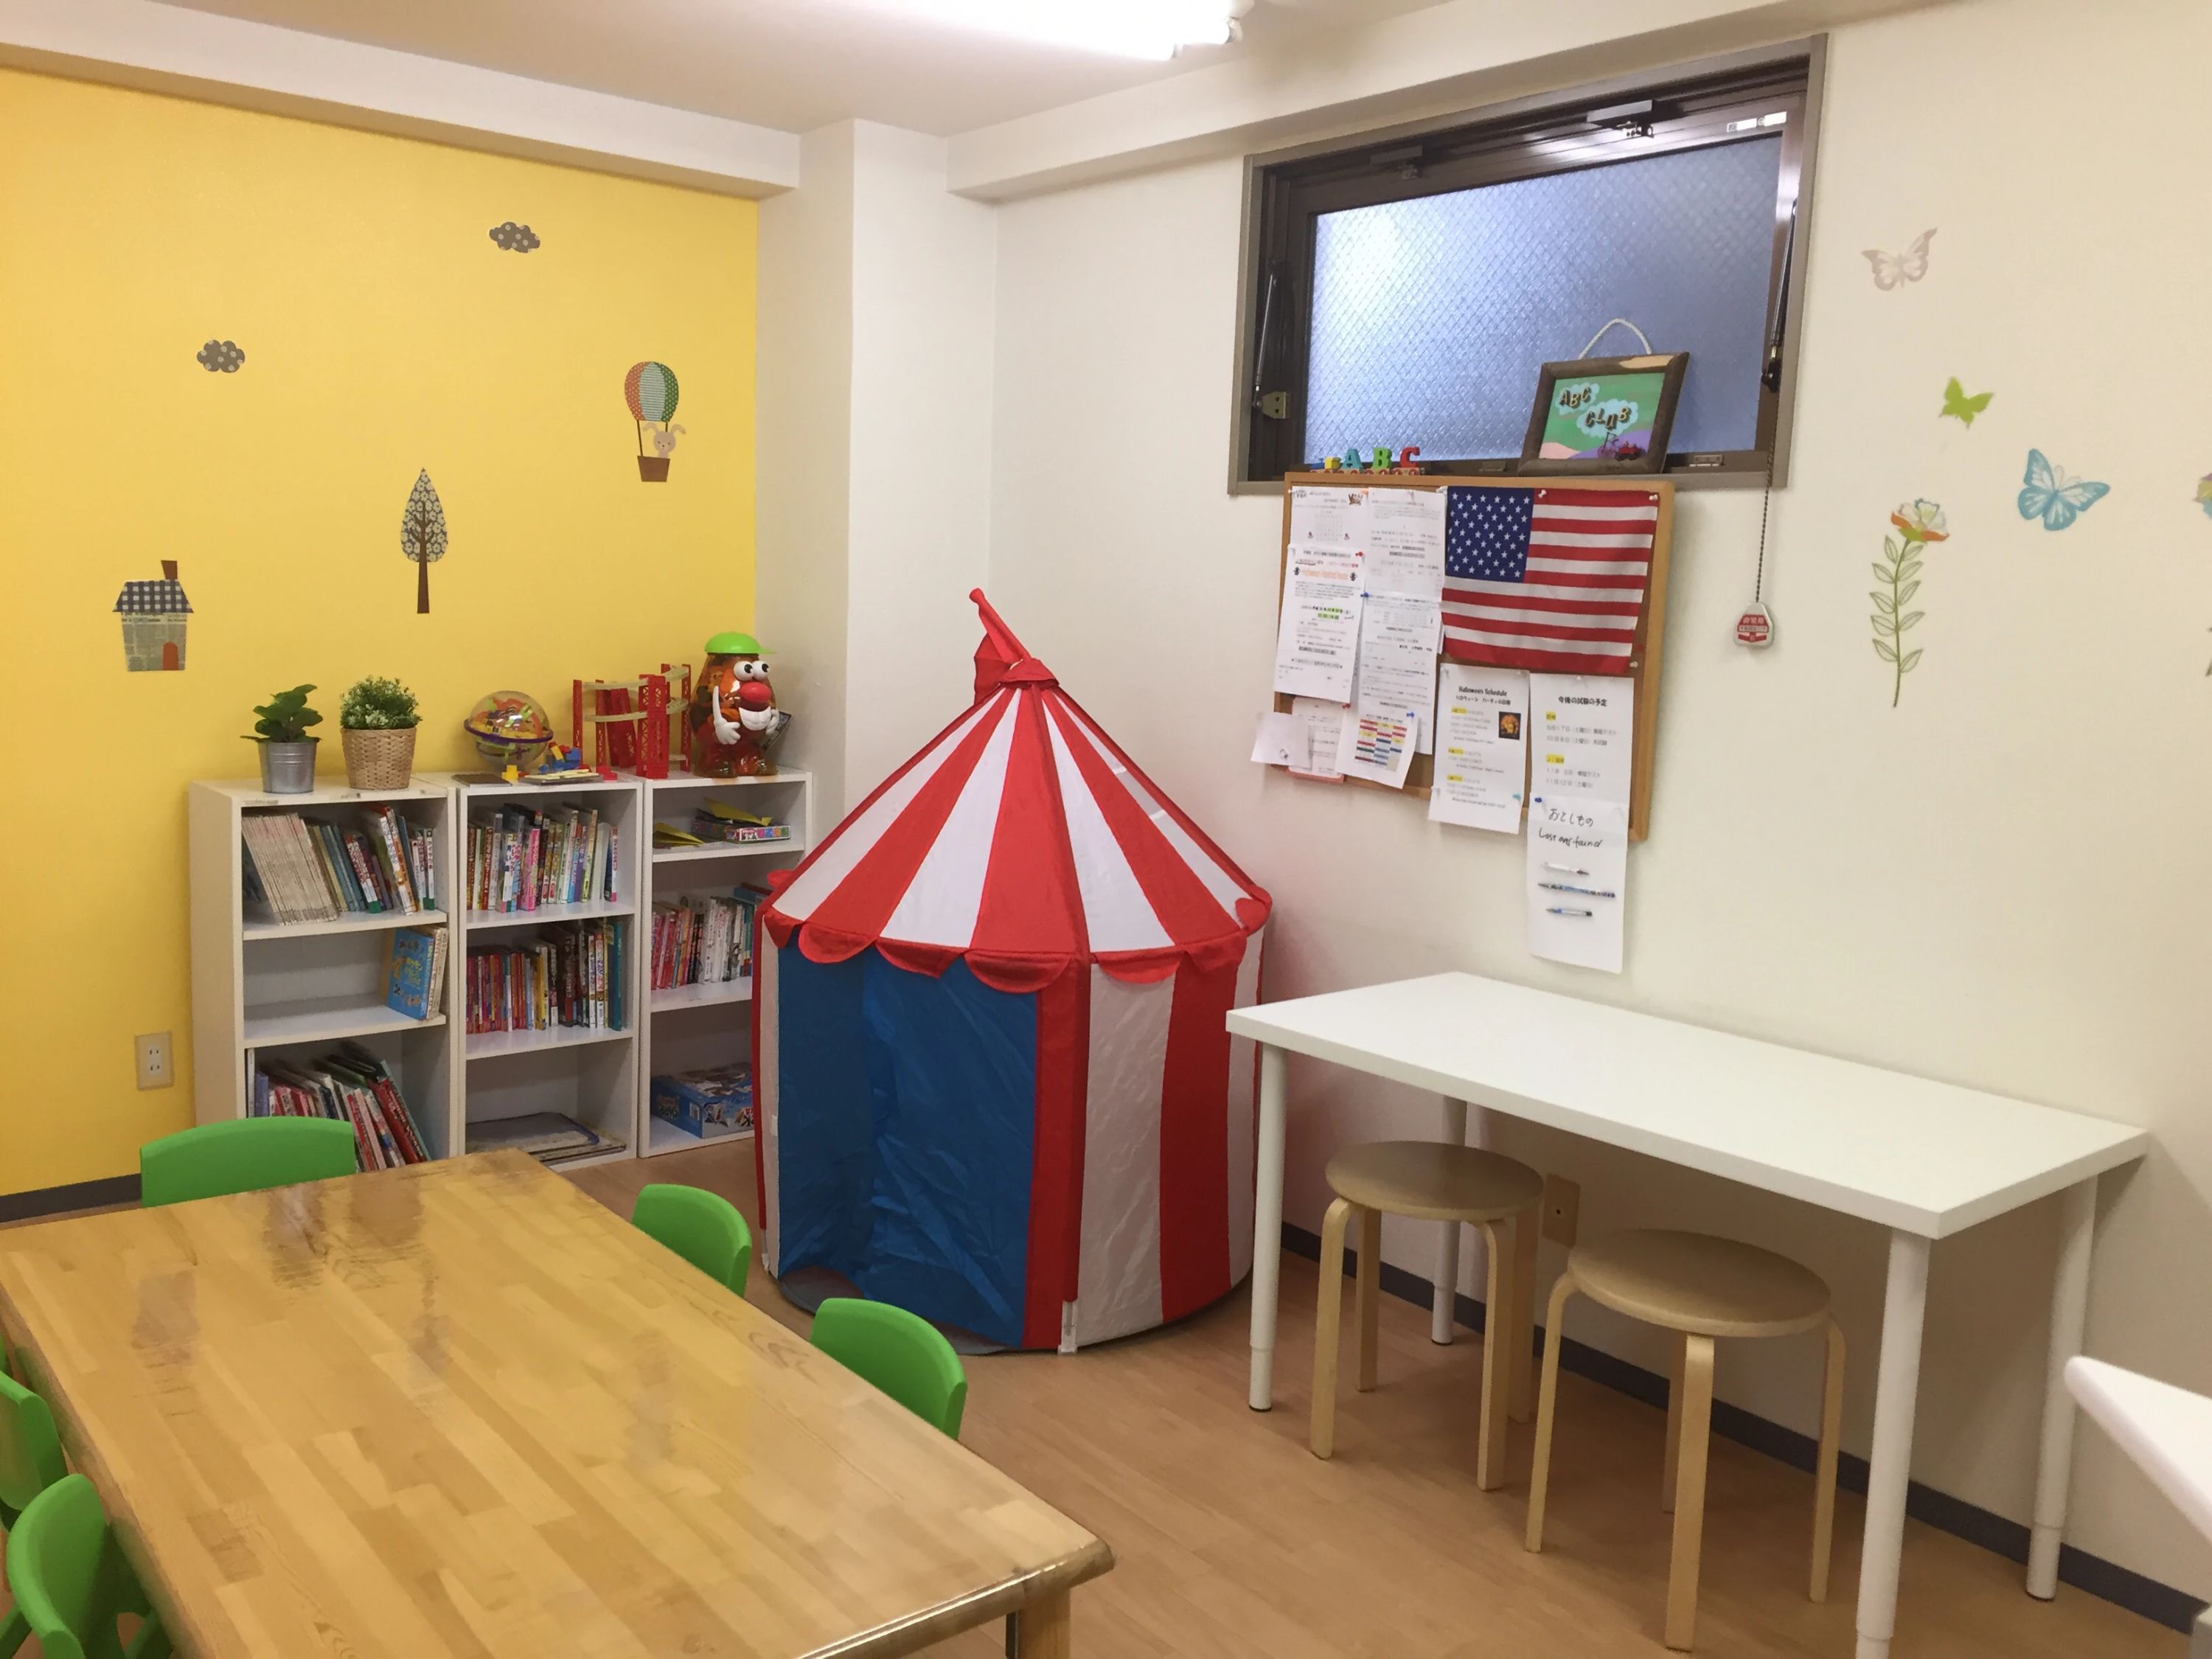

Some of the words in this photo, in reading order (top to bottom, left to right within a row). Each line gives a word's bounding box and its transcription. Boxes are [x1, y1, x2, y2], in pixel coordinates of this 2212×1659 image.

[1559, 386, 1592, 409] ABC
[1585, 406, 1632, 431] CLUB
[1484, 688, 1507, 697] Schedule
[1548, 808, 1593, 827] おとしもの
[1573, 835, 1603, 849] found
